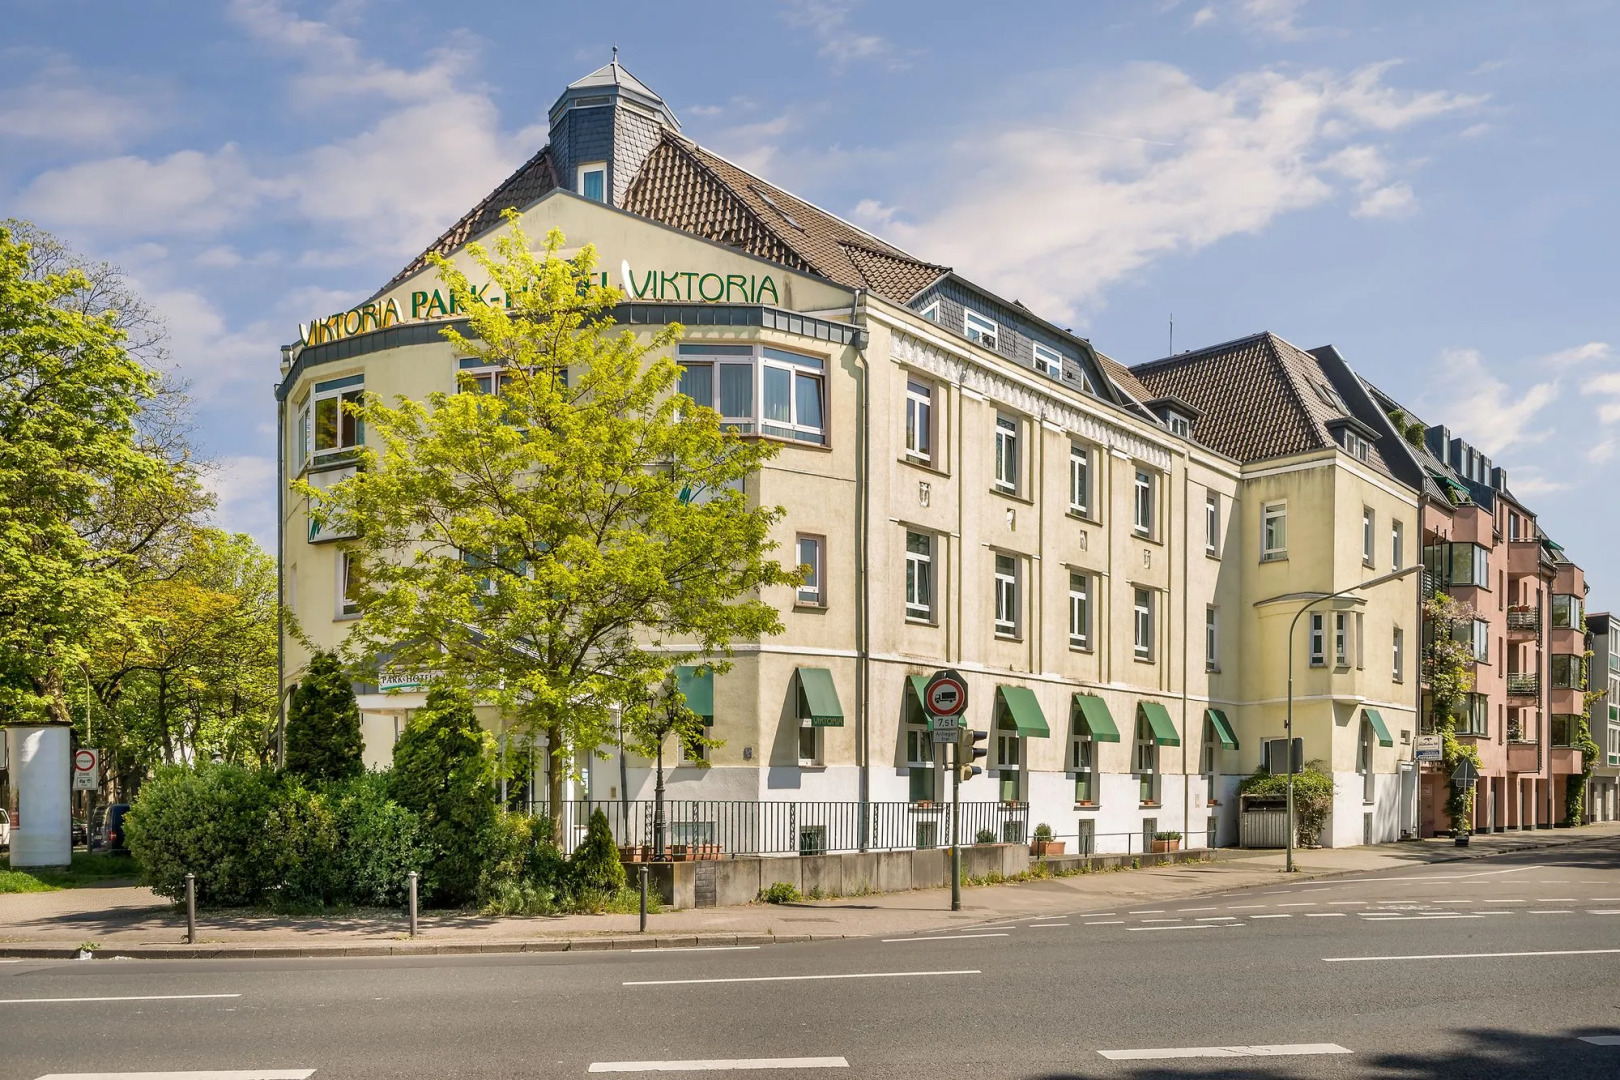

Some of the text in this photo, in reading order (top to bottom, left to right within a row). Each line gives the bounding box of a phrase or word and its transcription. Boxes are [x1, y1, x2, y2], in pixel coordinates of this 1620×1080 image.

[299, 269, 779, 347] VIKTORIA PARK-E VIKTORIA
